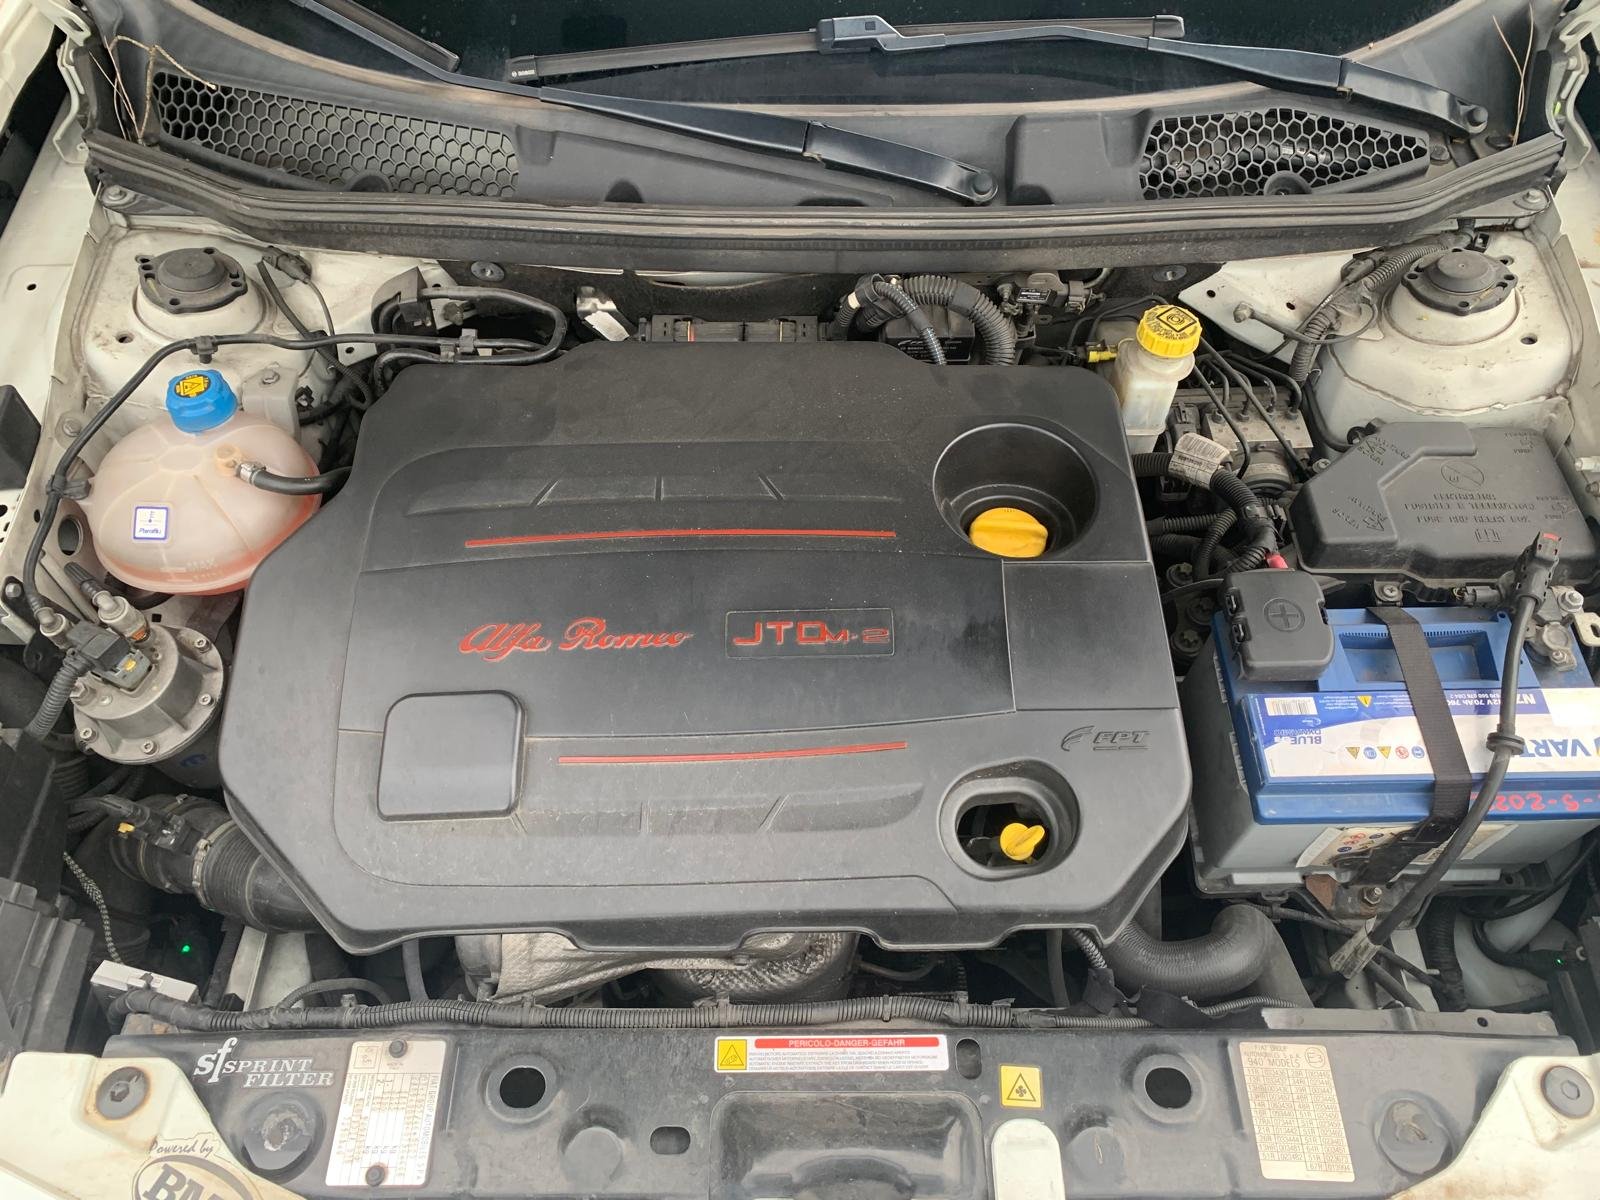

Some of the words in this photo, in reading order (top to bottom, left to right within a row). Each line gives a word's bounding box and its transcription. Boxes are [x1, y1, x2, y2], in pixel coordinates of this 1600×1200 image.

[458, 622, 552, 662] Alfa
[558, 617, 695, 651] Romeo
[1517, 693, 1536, 705] N7
[1290, 735, 1322, 744] BLUE
[1518, 738, 1592, 758] VART
[788, 1038, 906, 1048] PERICOLO-DANGER-GEFAHR
[222, 1058, 314, 1075] SPRINT
[1247, 1058, 1264, 1067] 940
[1268, 1058, 1301, 1069] MODELS
[243, 1071, 335, 1089] FILTER
[149, 1139, 196, 1154] Powered
[200, 1138, 214, 1158] by
